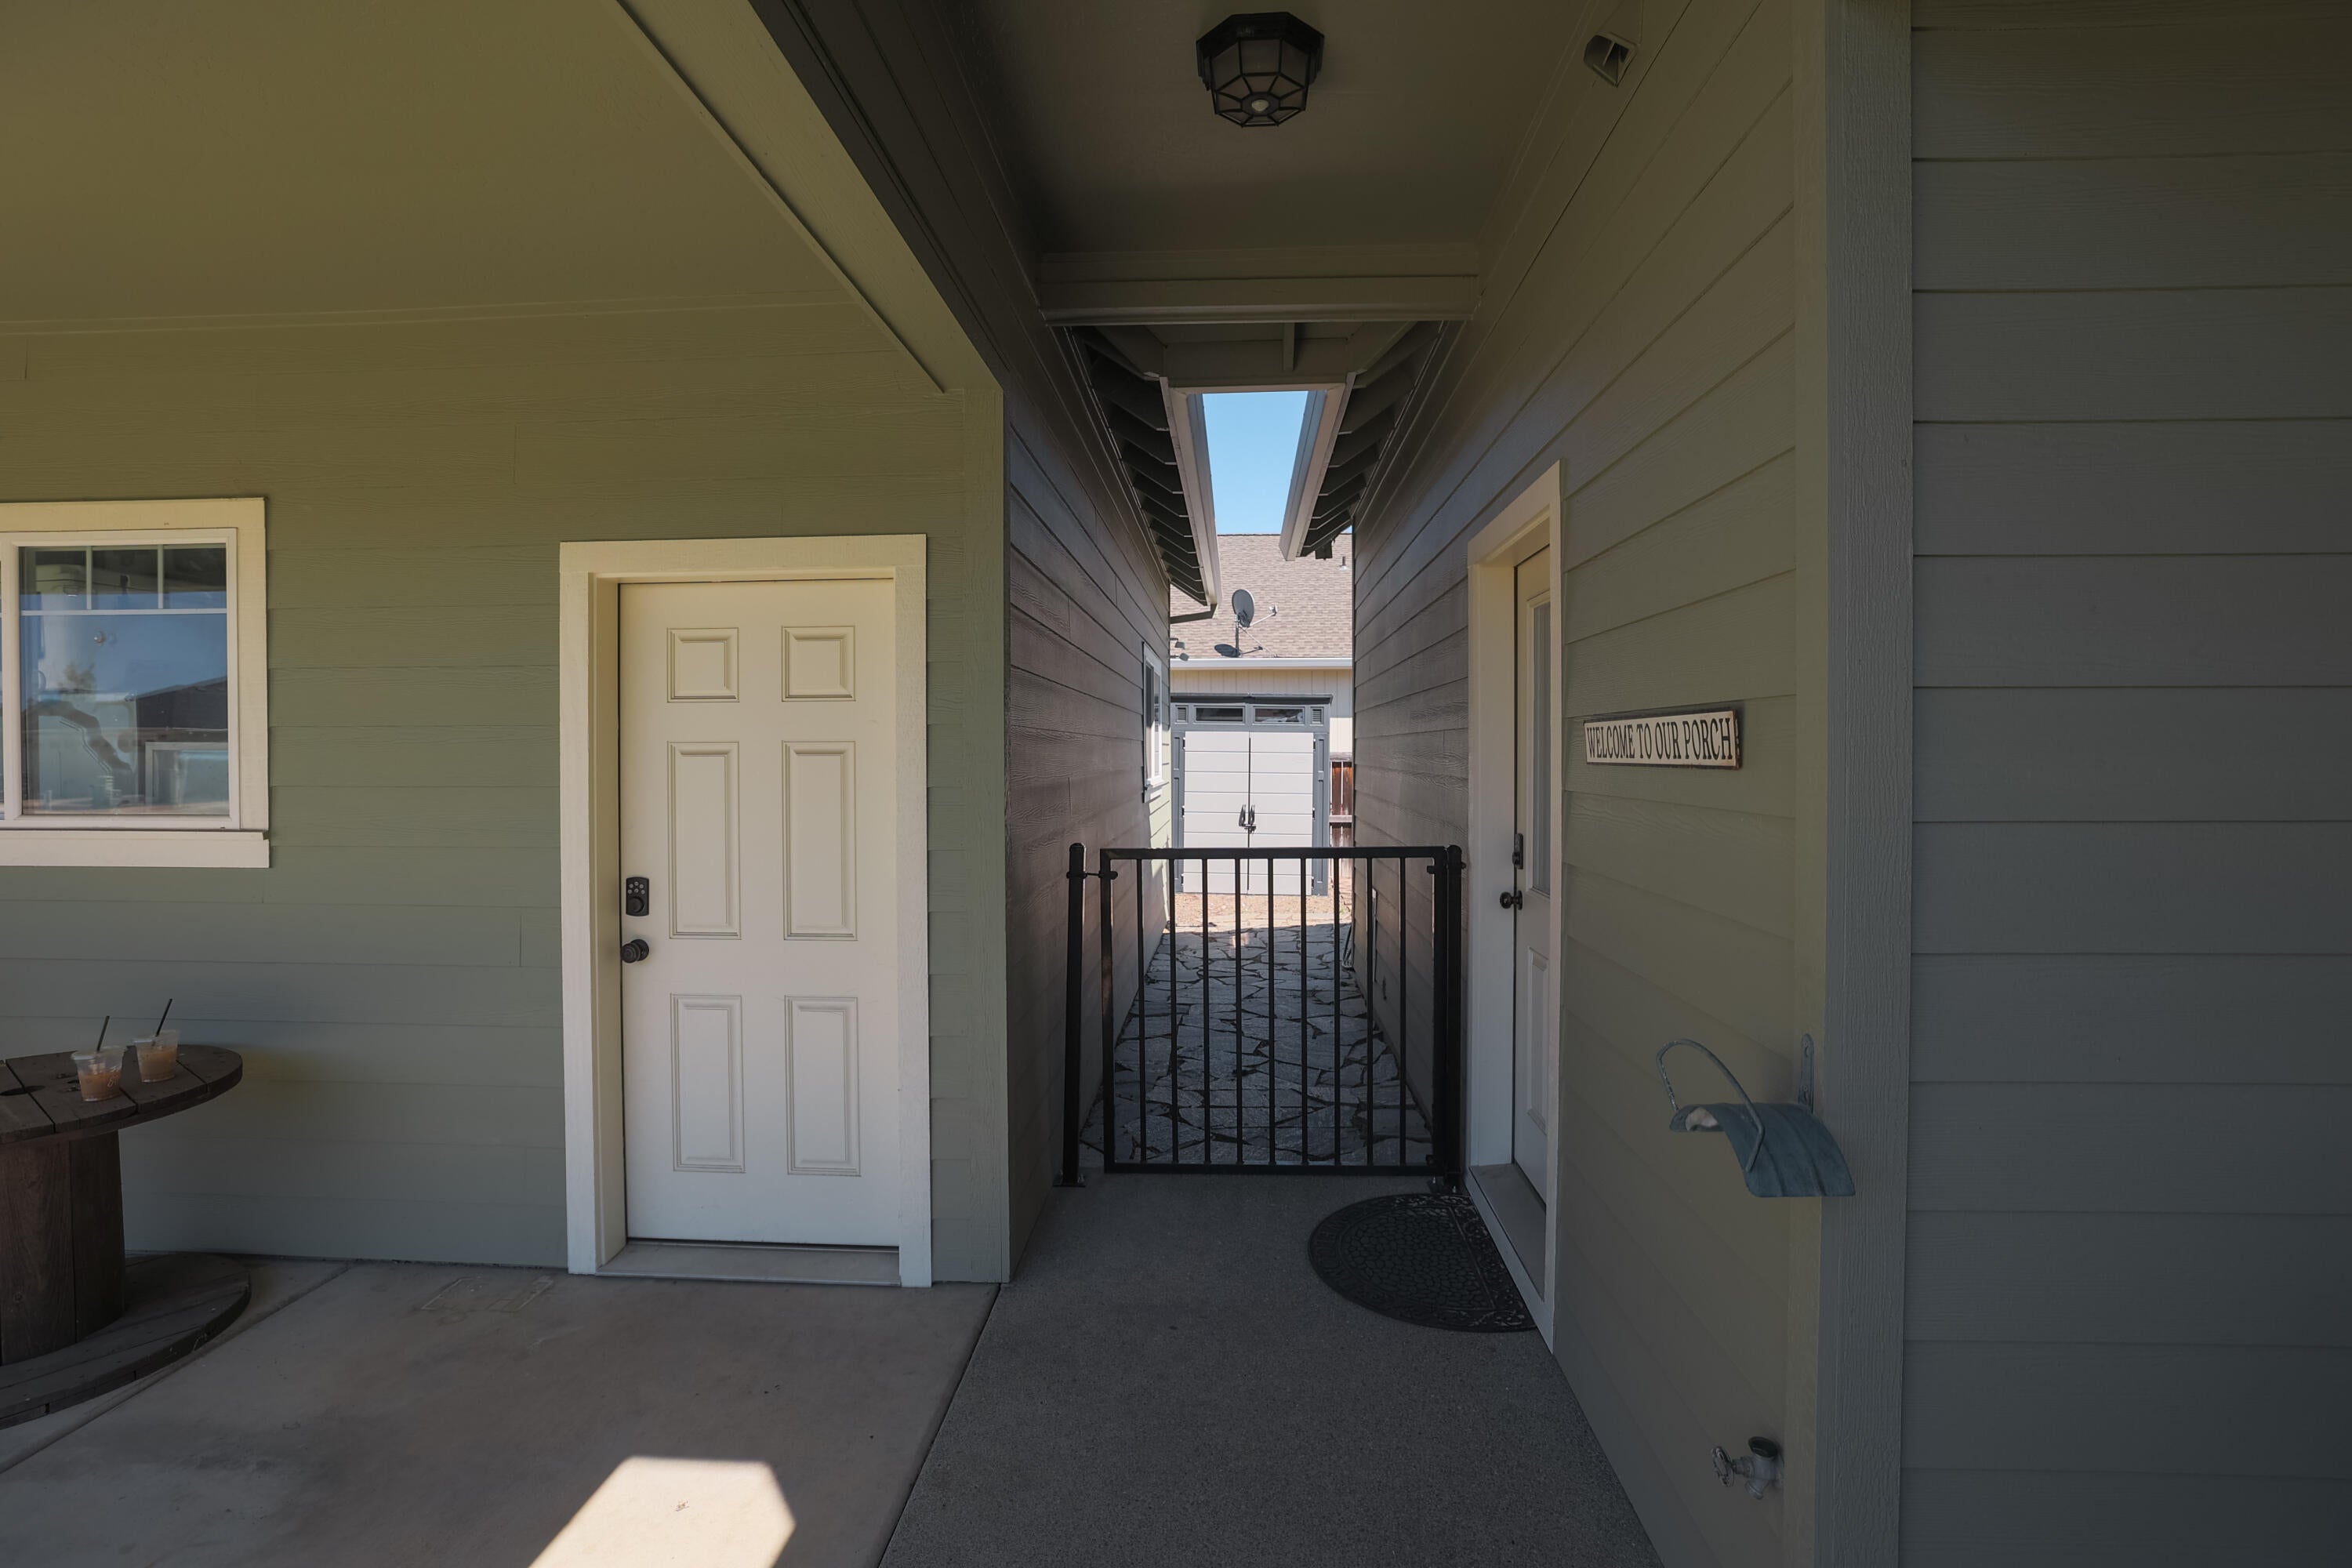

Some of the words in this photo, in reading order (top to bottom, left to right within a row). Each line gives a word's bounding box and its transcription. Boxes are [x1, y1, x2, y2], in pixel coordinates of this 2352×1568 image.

[1587, 724, 1635, 759] WELCOME
[1637, 724, 1652, 759] TO
[1655, 722, 1681, 759] OUR
[1682, 718, 1732, 760] PORCH
